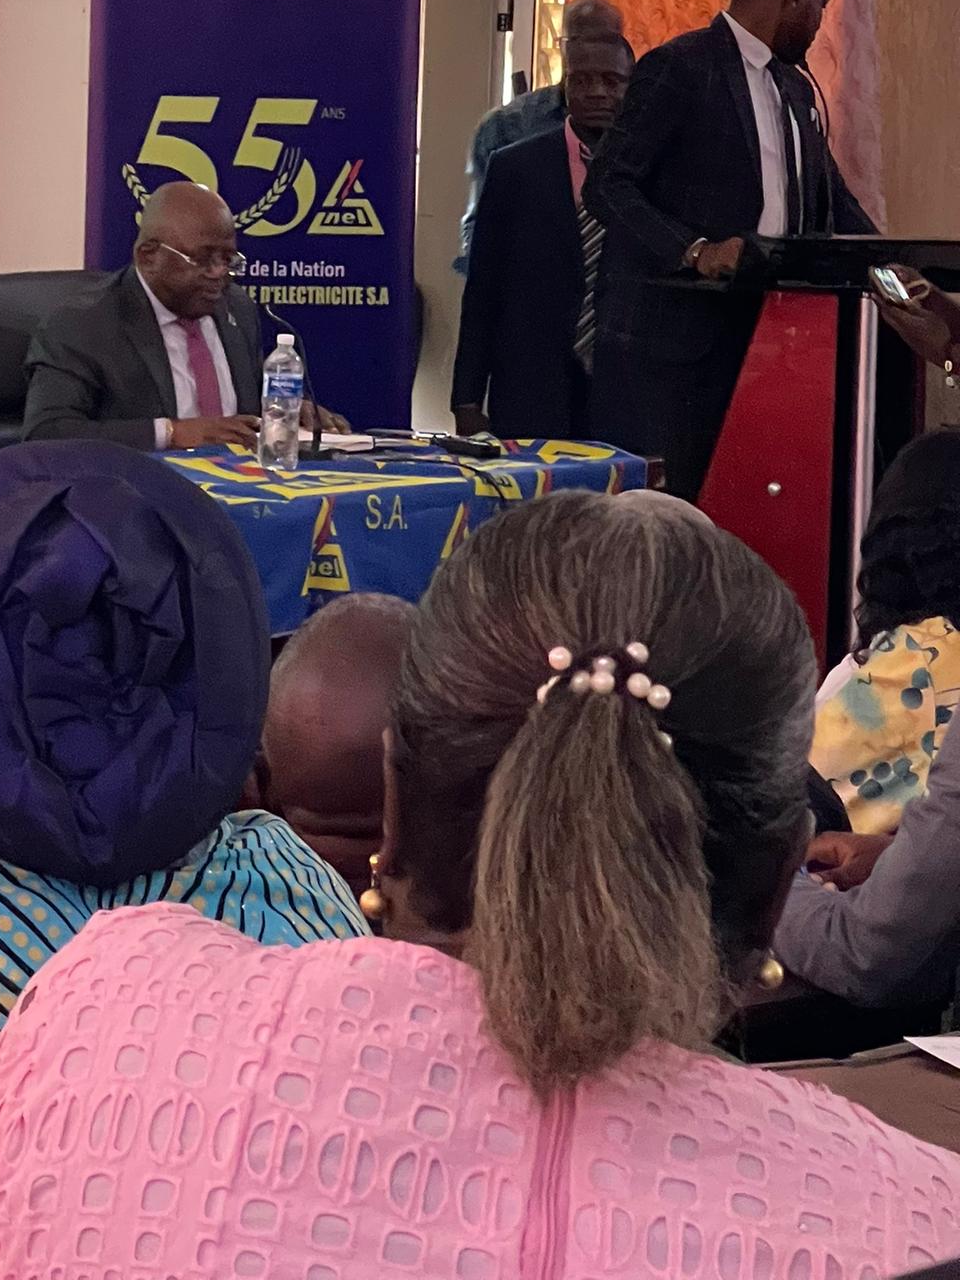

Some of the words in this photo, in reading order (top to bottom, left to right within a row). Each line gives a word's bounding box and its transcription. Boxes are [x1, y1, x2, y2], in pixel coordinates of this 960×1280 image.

[249, 260, 270, 277] de
[273, 260, 288, 277] la
[291, 261, 345, 278] Nation
[260, 285, 364, 305] D'ELECTRICITE
[365, 494, 408, 530] S.A.
